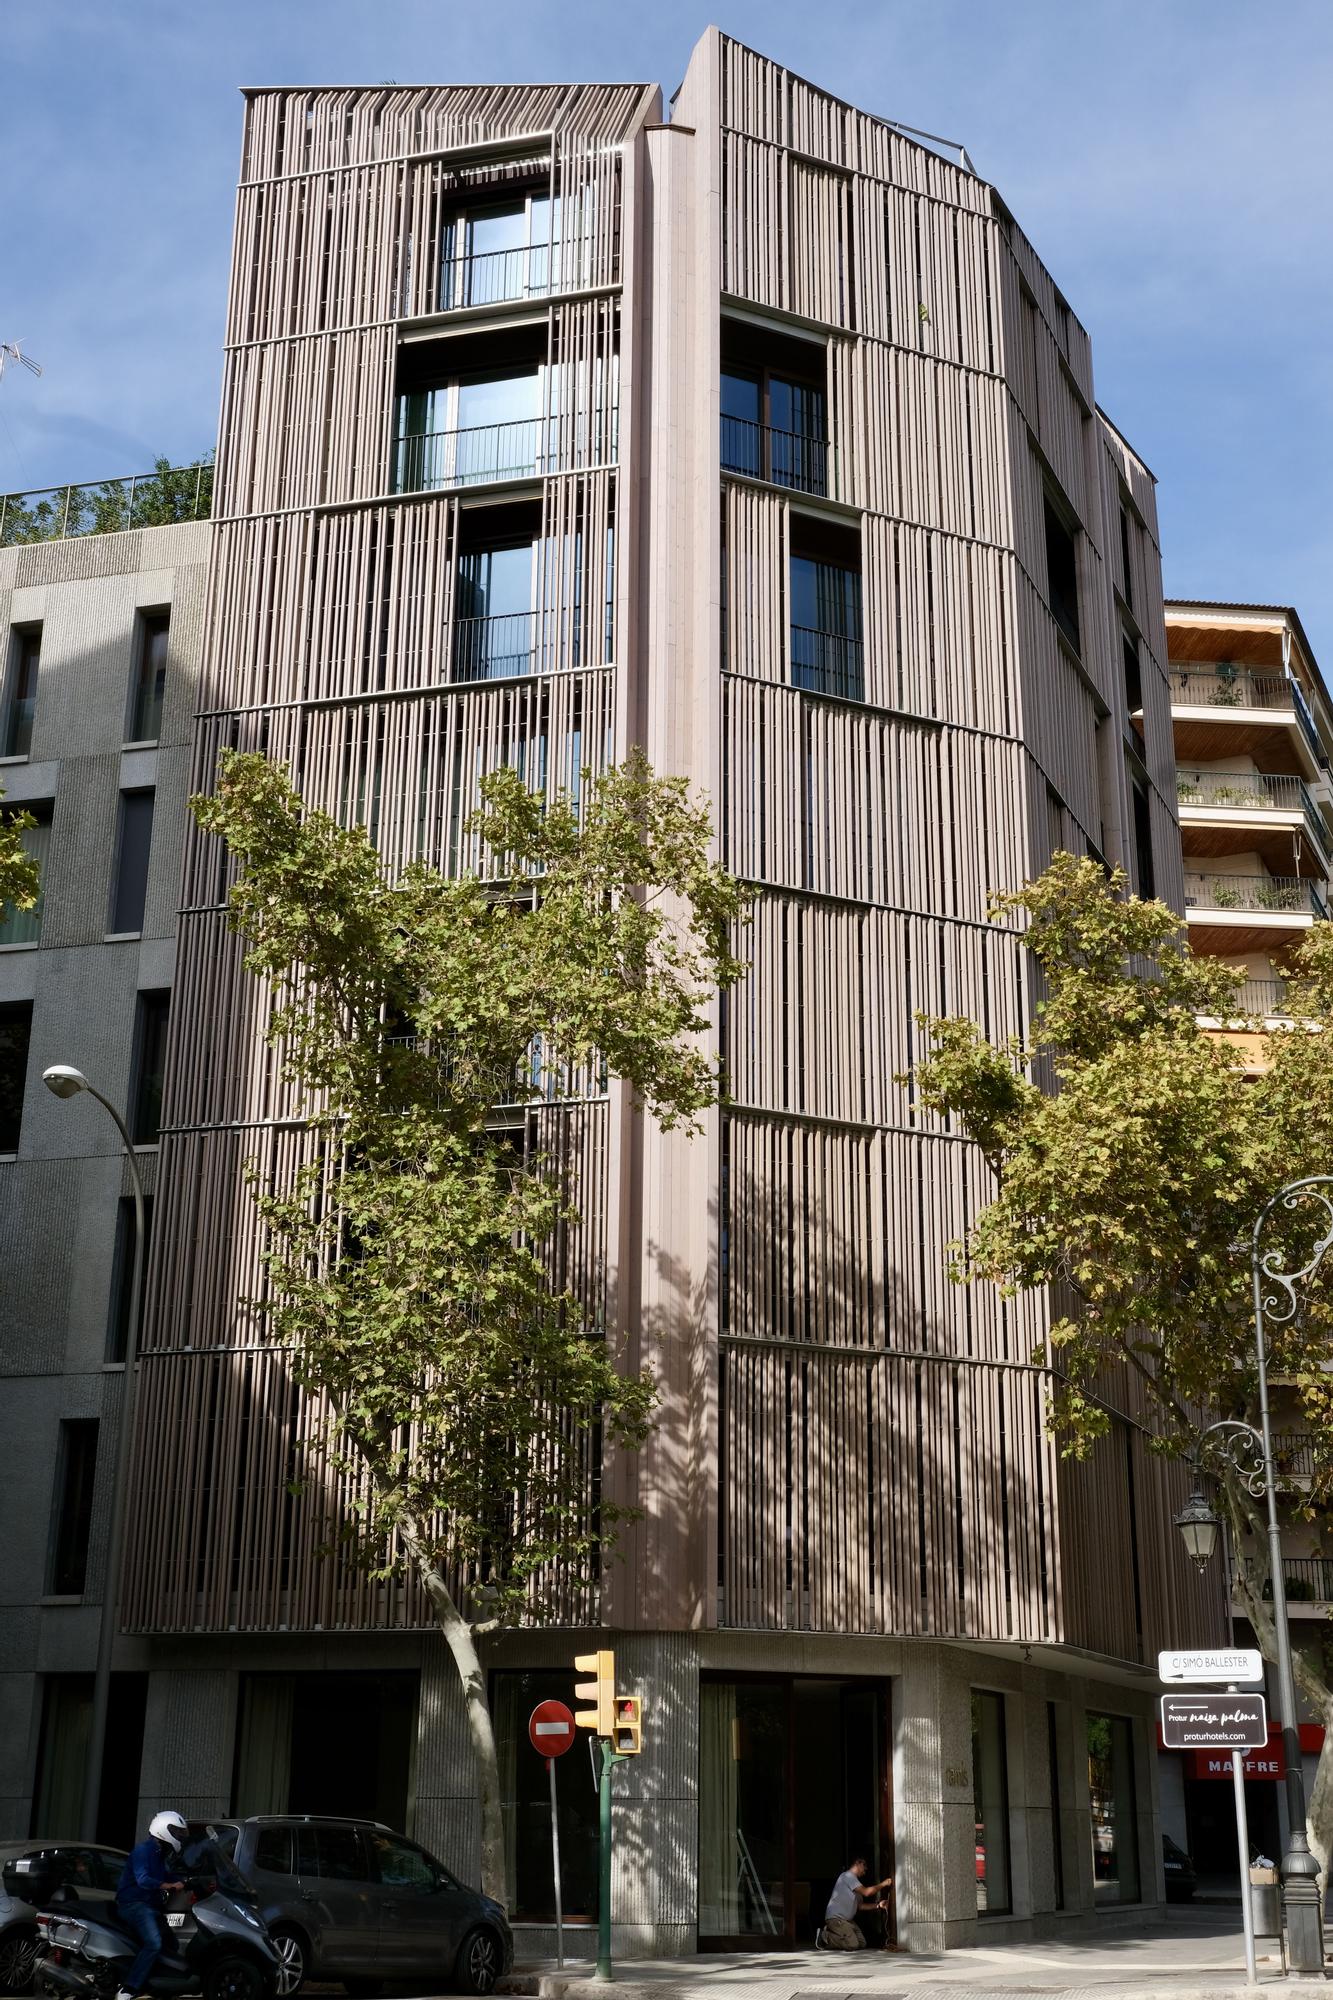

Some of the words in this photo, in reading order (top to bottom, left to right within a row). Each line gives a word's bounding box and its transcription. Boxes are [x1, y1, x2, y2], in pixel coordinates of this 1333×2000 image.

[1183, 1655, 1204, 1668] SIMÓ
[1205, 1656, 1249, 1667] BALLESTER
[1189, 1713, 1219, 1724] naisa
[1220, 1709, 1259, 1726] palma
[1183, 1732, 1246, 1742] proturhotels.com
[1208, 1761, 1279, 1772] MAFRE
